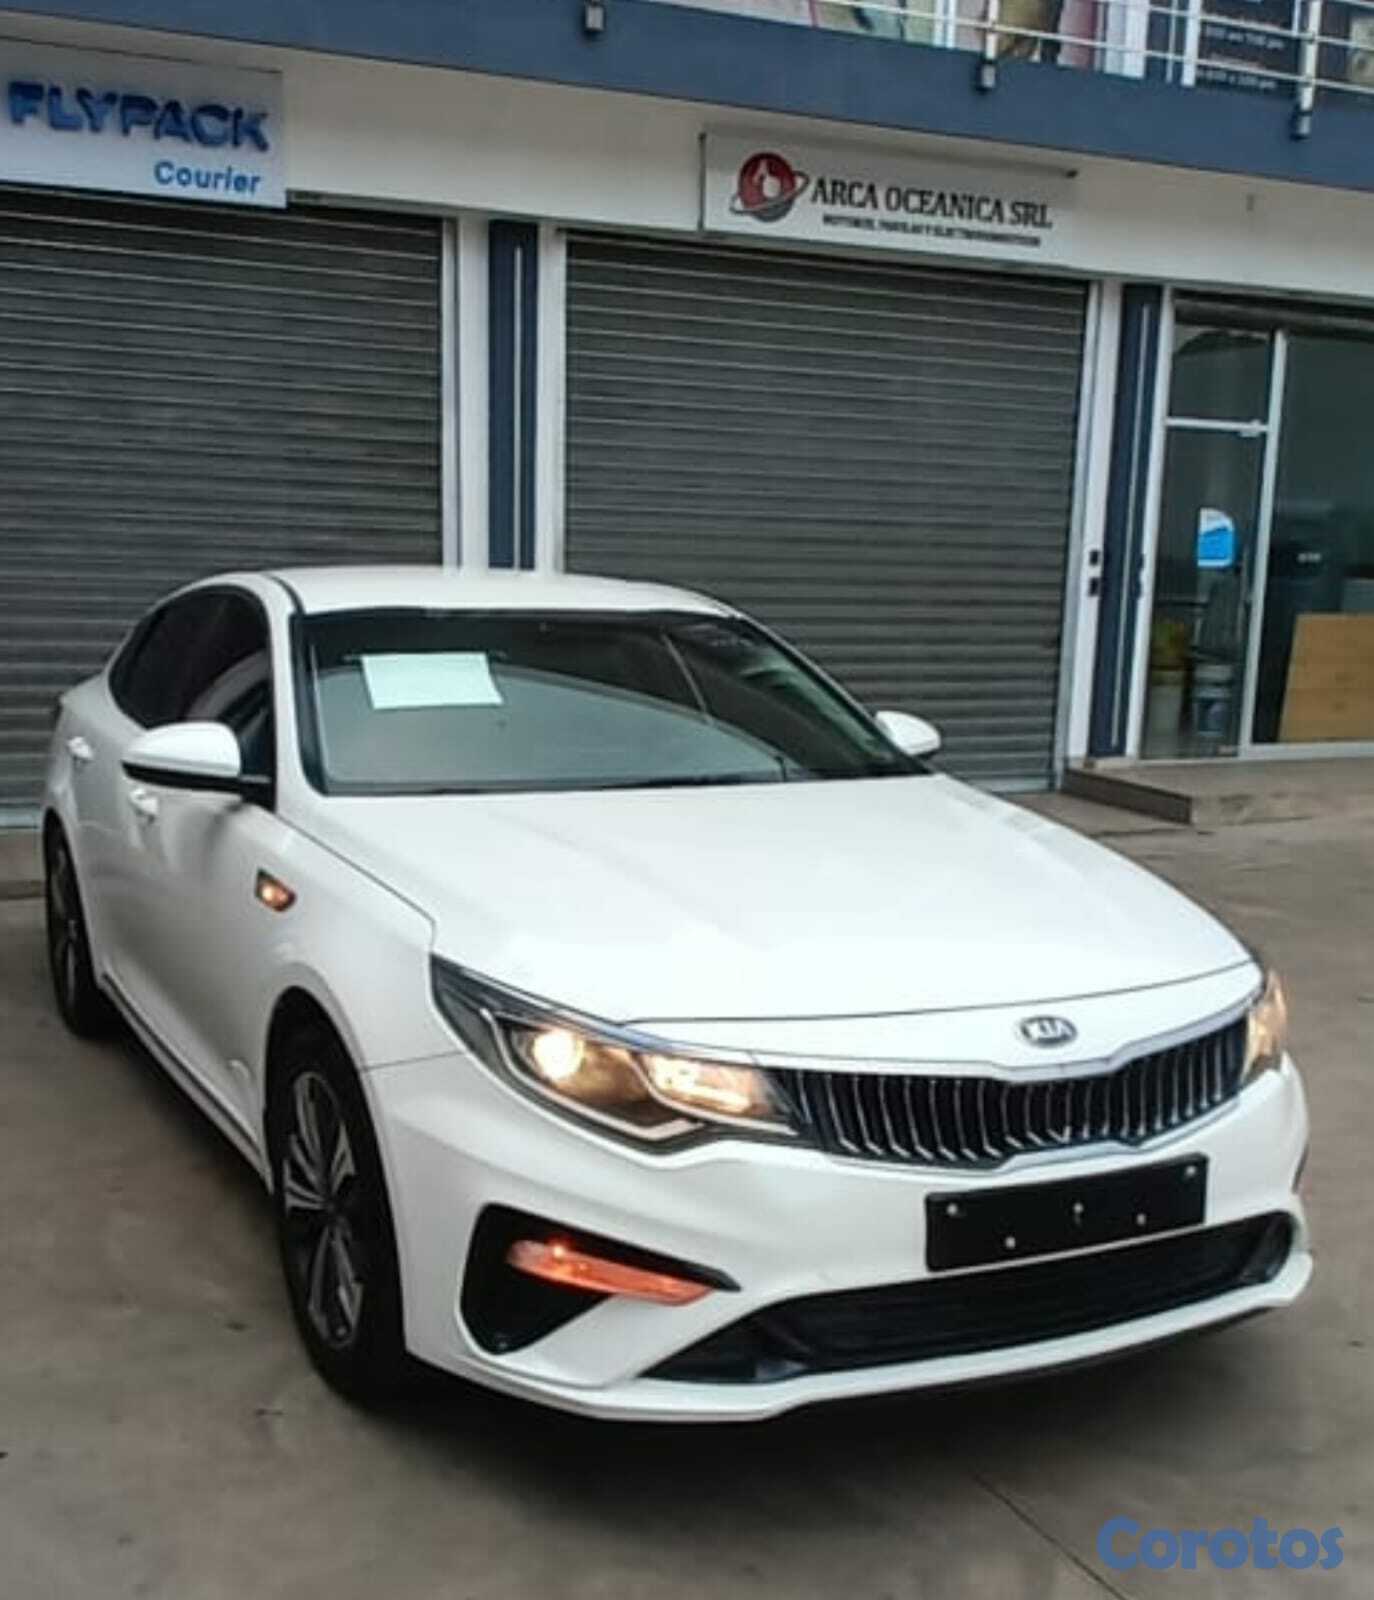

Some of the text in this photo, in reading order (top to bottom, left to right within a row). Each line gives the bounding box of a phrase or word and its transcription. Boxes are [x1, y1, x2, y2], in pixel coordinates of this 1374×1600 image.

[8, 80, 270, 152] FLYPACK
[153, 160, 262, 194] Courier
[811, 177, 1053, 229] ARCA OCEANICA SRL
